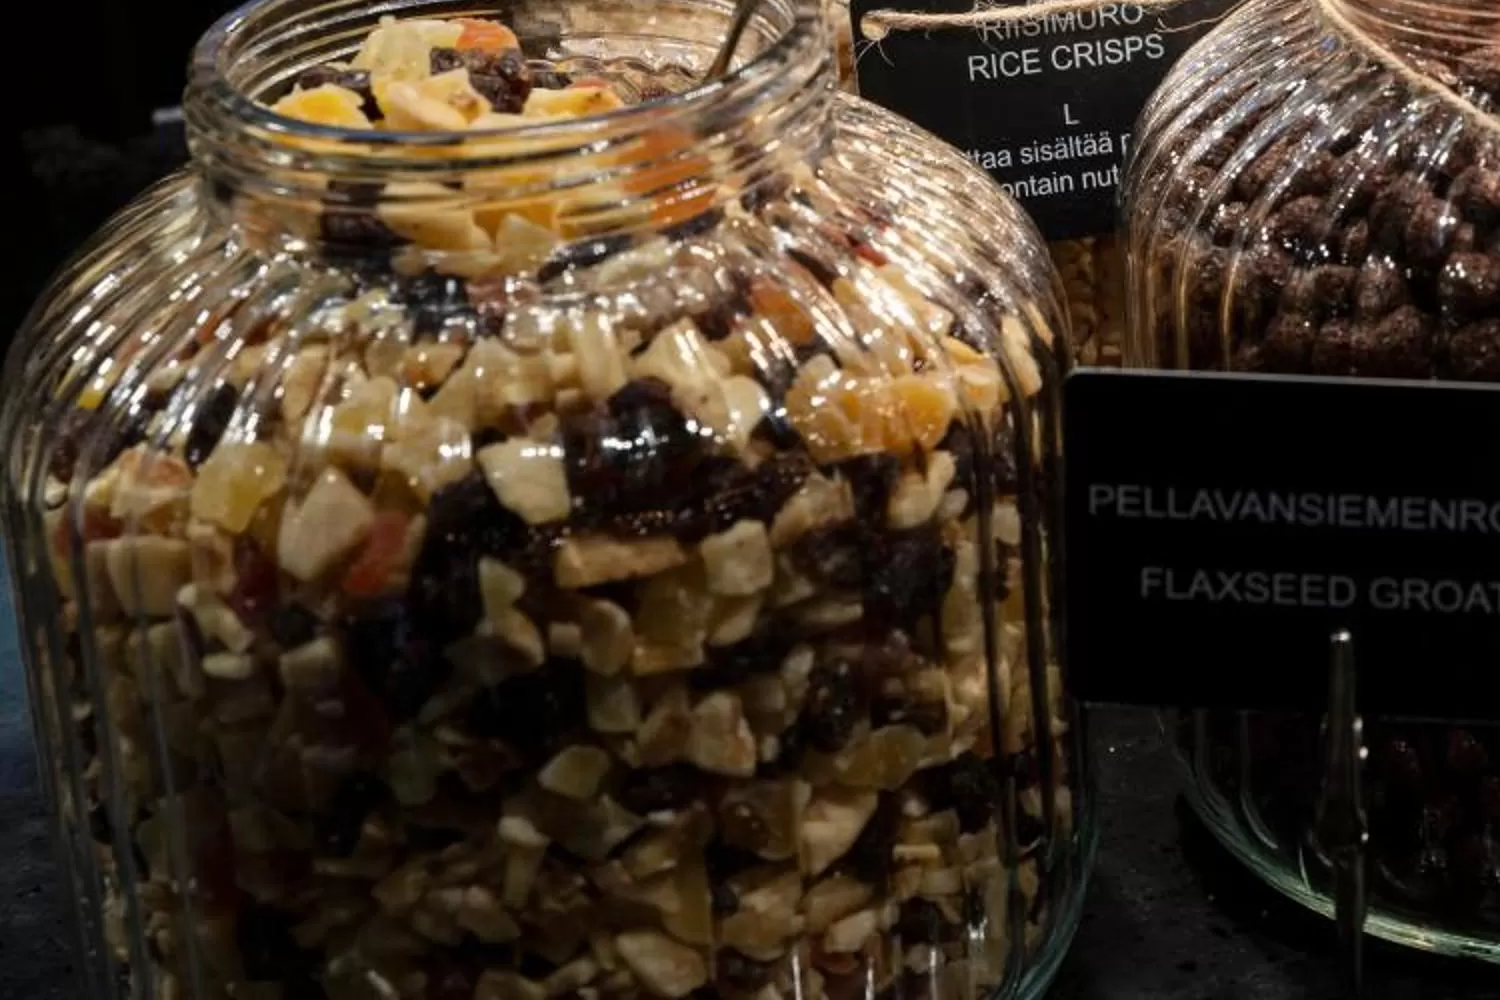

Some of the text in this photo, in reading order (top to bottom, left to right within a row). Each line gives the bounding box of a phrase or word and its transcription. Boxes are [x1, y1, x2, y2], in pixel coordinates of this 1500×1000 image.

[981, 3, 1144, 42] RIISIMURO
[967, 34, 1165, 82] RICE CRISPS
[1063, 103, 1080, 125] L
[1019, 130, 1113, 165] sisältää
[1001, 163, 1120, 199] ontain nut
[1139, 566, 1357, 608] FLAXSEED
